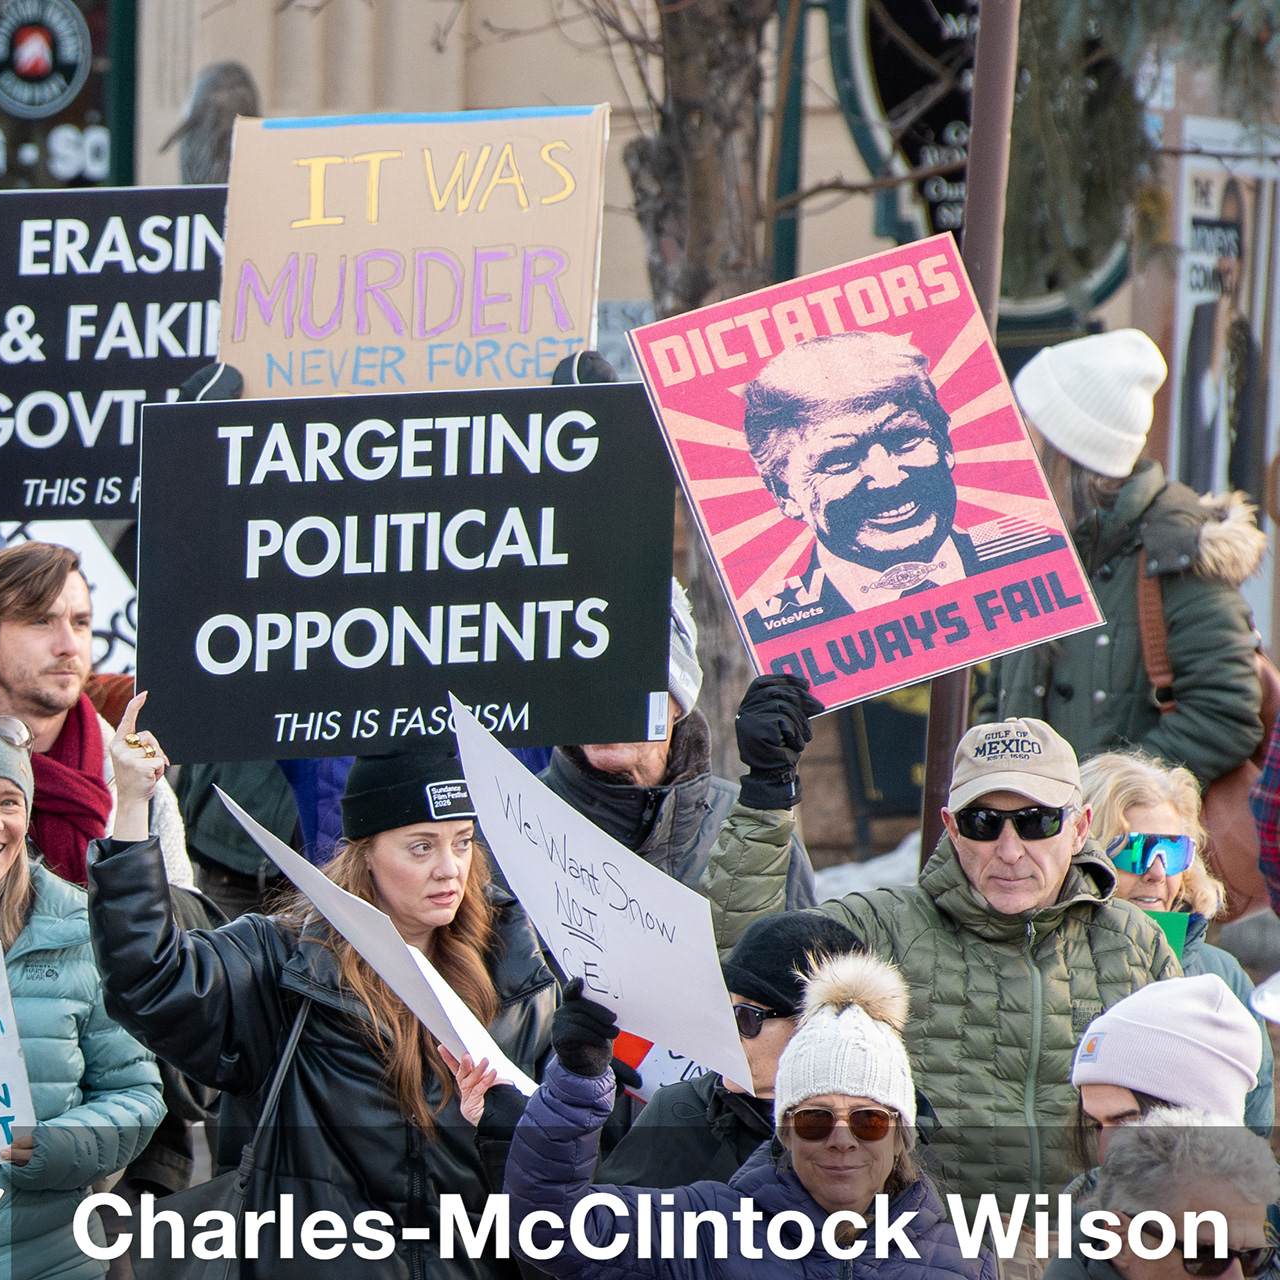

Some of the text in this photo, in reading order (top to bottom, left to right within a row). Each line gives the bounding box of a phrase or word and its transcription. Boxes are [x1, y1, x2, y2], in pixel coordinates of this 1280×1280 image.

[290, 140, 577, 228] IT WAS
[232, 244, 575, 343] MURDER
[649, 253, 961, 388] DICTATORS
[265, 345, 408, 389] NEVER
[426, 336, 585, 383] FORGET
[218, 410, 599, 486] TARGETING
[23, 476, 122, 506] THIS IS
[246, 507, 568, 579] POLITICAL
[195, 599, 610, 676] OPPONENTS
[764, 605, 824, 631] VoteVets
[769, 570, 1085, 687] ALWAYS FAIL
[274, 711, 343, 743] THIS
[351, 708, 381, 740] IS
[972, 739, 1042, 758] MEXICO
[984, 730, 1011, 740] GULF
[986, 754, 1006, 762] EST.
[431, 786, 461, 794] Sundance
[433, 791, 468, 801] Film Festival
[434, 799, 451, 808] 2026
[495, 776, 676, 943] We Want Snow
[555, 881, 597, 932] NOT
